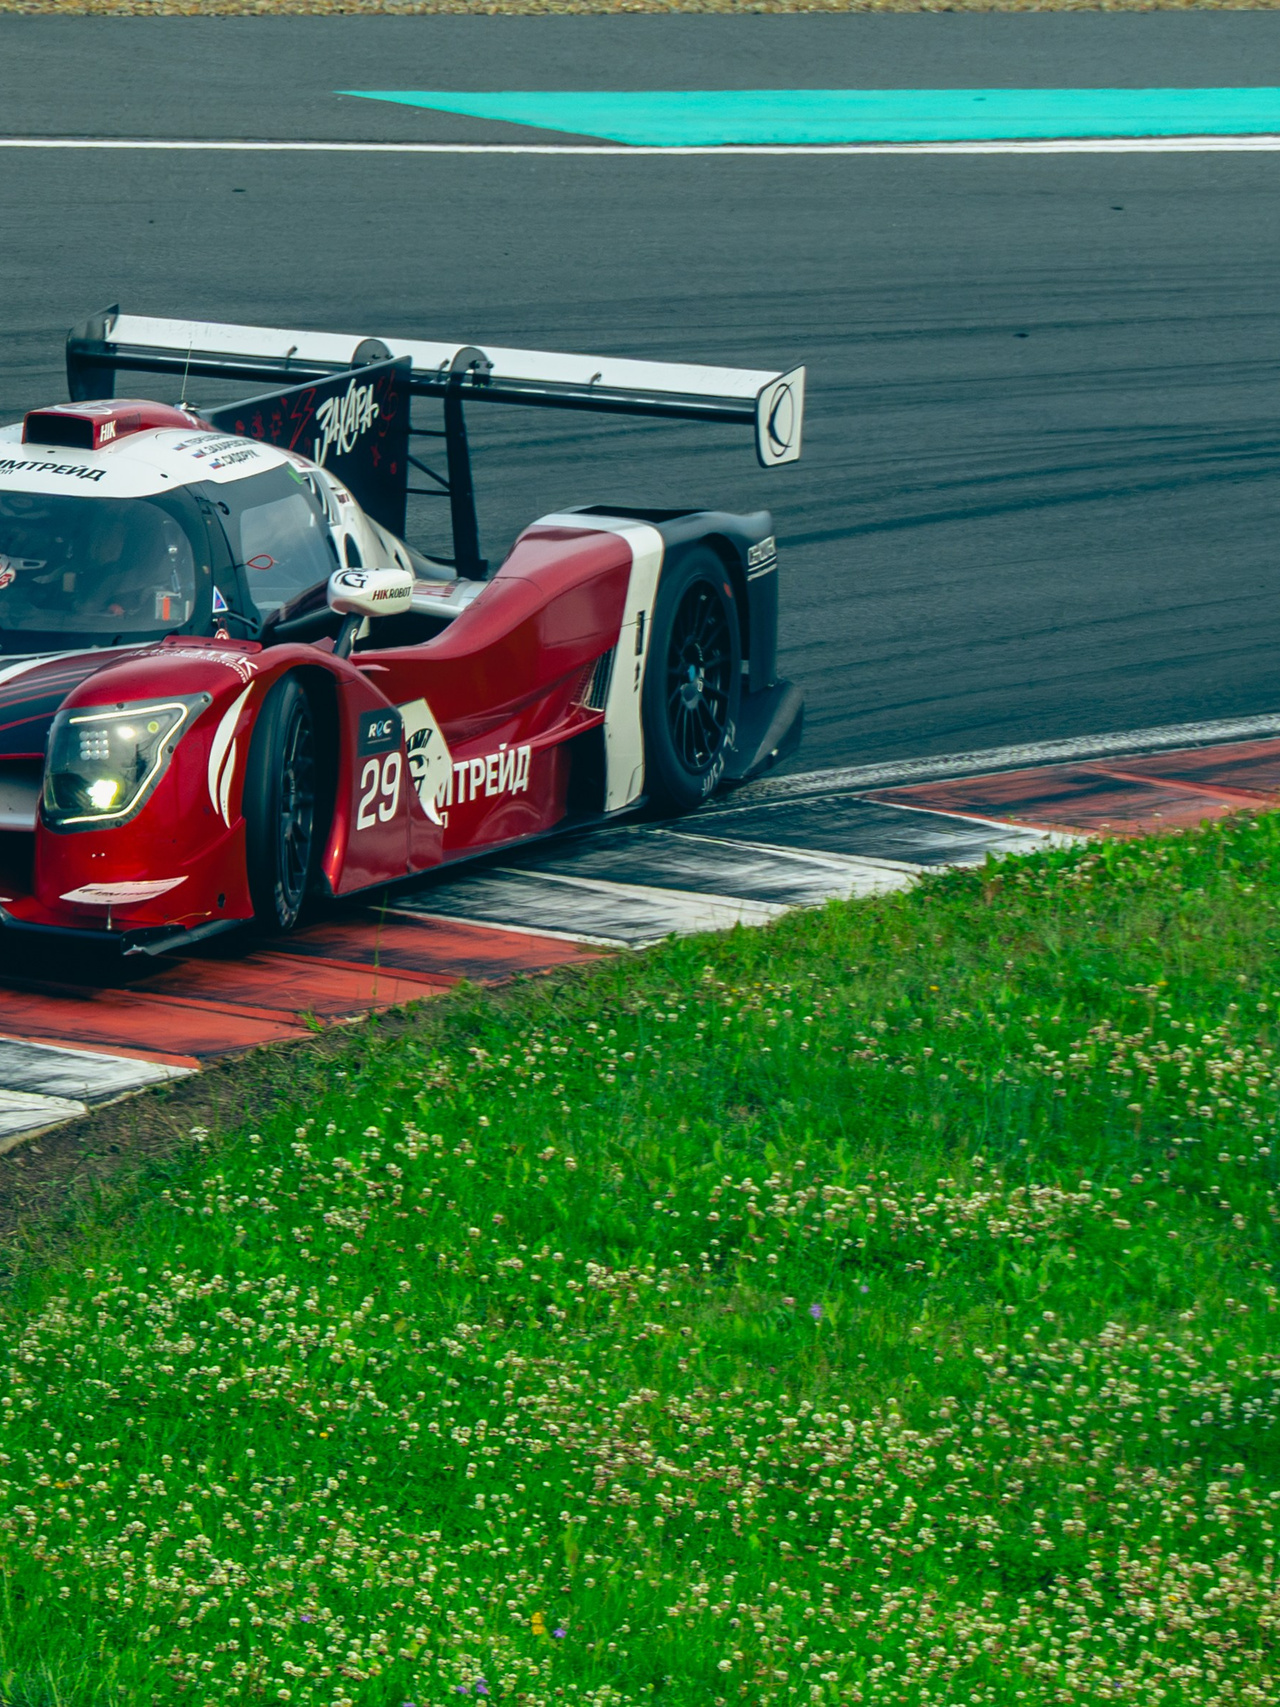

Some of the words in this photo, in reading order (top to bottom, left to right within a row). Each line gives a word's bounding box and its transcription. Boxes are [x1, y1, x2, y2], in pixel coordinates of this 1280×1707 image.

[372, 587, 411, 600] HIKROBOT
[356, 752, 402, 830] 29
[434, 743, 531, 808] МТРЕЙД
